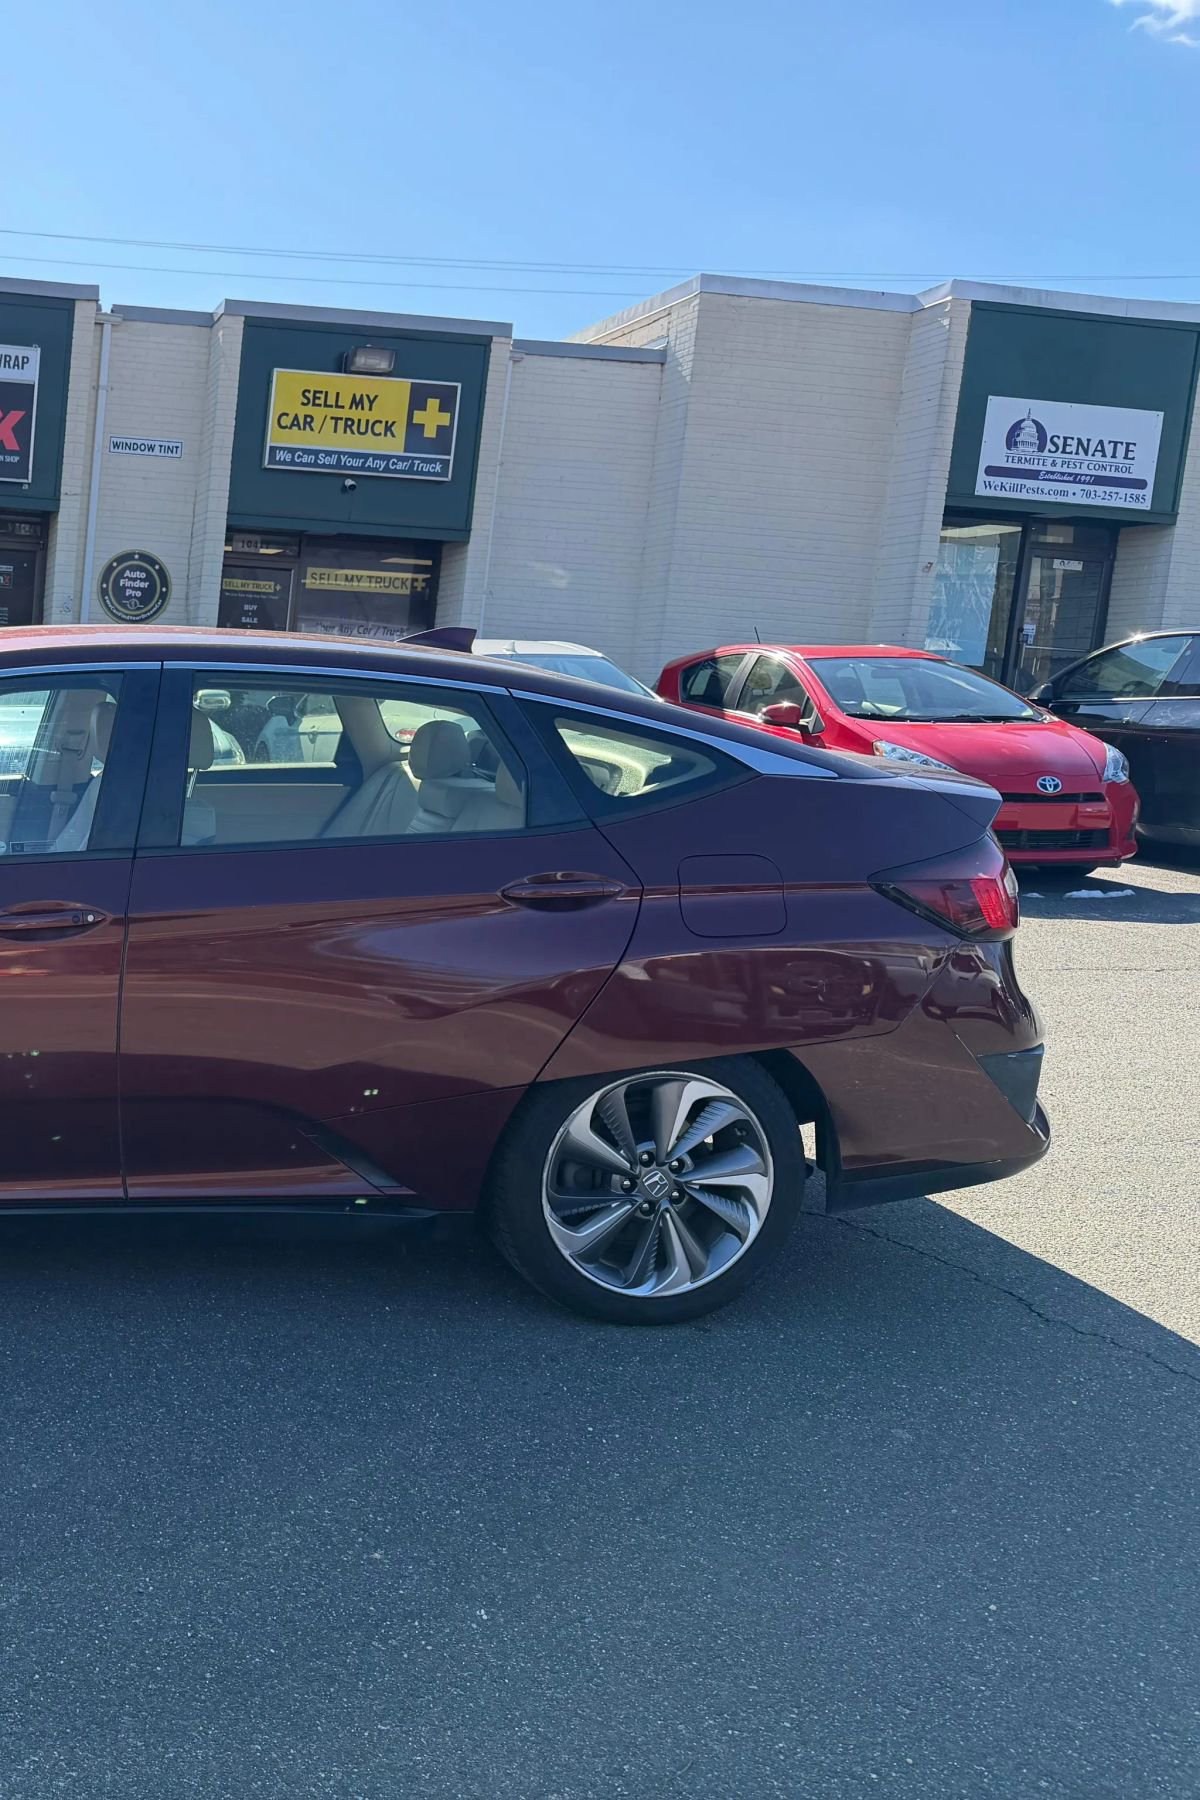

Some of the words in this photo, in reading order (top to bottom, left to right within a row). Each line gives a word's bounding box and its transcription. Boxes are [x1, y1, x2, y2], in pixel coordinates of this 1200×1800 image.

[301, 389, 345, 411] SELL
[348, 391, 379, 412] MY
[277, 412, 314, 432] CAR
[330, 416, 397, 439] TRUCK
[112, 441, 155, 454] WINDOW
[158, 443, 180, 456] TINT
[1048, 434, 1137, 460] SENATE
[4, 455, 20, 463] SHOP
[275, 449, 292, 463] We
[295, 451, 315, 464] Can
[317, 452, 337, 466] Sell
[340, 454, 363, 468] Your
[365, 456, 387, 471] Any
[390, 457, 411, 471] Car/
[413, 459, 442, 473] Truck
[1005, 455, 1048, 467] TERMITE
[1050, 459, 1058, 468] &
[1060, 460, 1085, 471] PEST
[1087, 463, 1134, 474] CONTROL
[1076, 475, 1095, 484] 1991
[983, 480, 1069, 498] WeKillPests.com
[1080, 488, 1147, 504] 703-257-1585
[123, 569, 147, 579] Auto
[310, 572, 339, 585] SELL
[345, 574, 363, 586] MY
[367, 575, 410, 590] TRUCK
[119, 578, 150, 589] Finder
[224, 580, 240, 589] SELL
[252, 582, 273, 591] TRUCK
[125, 588, 142, 598] Pro
